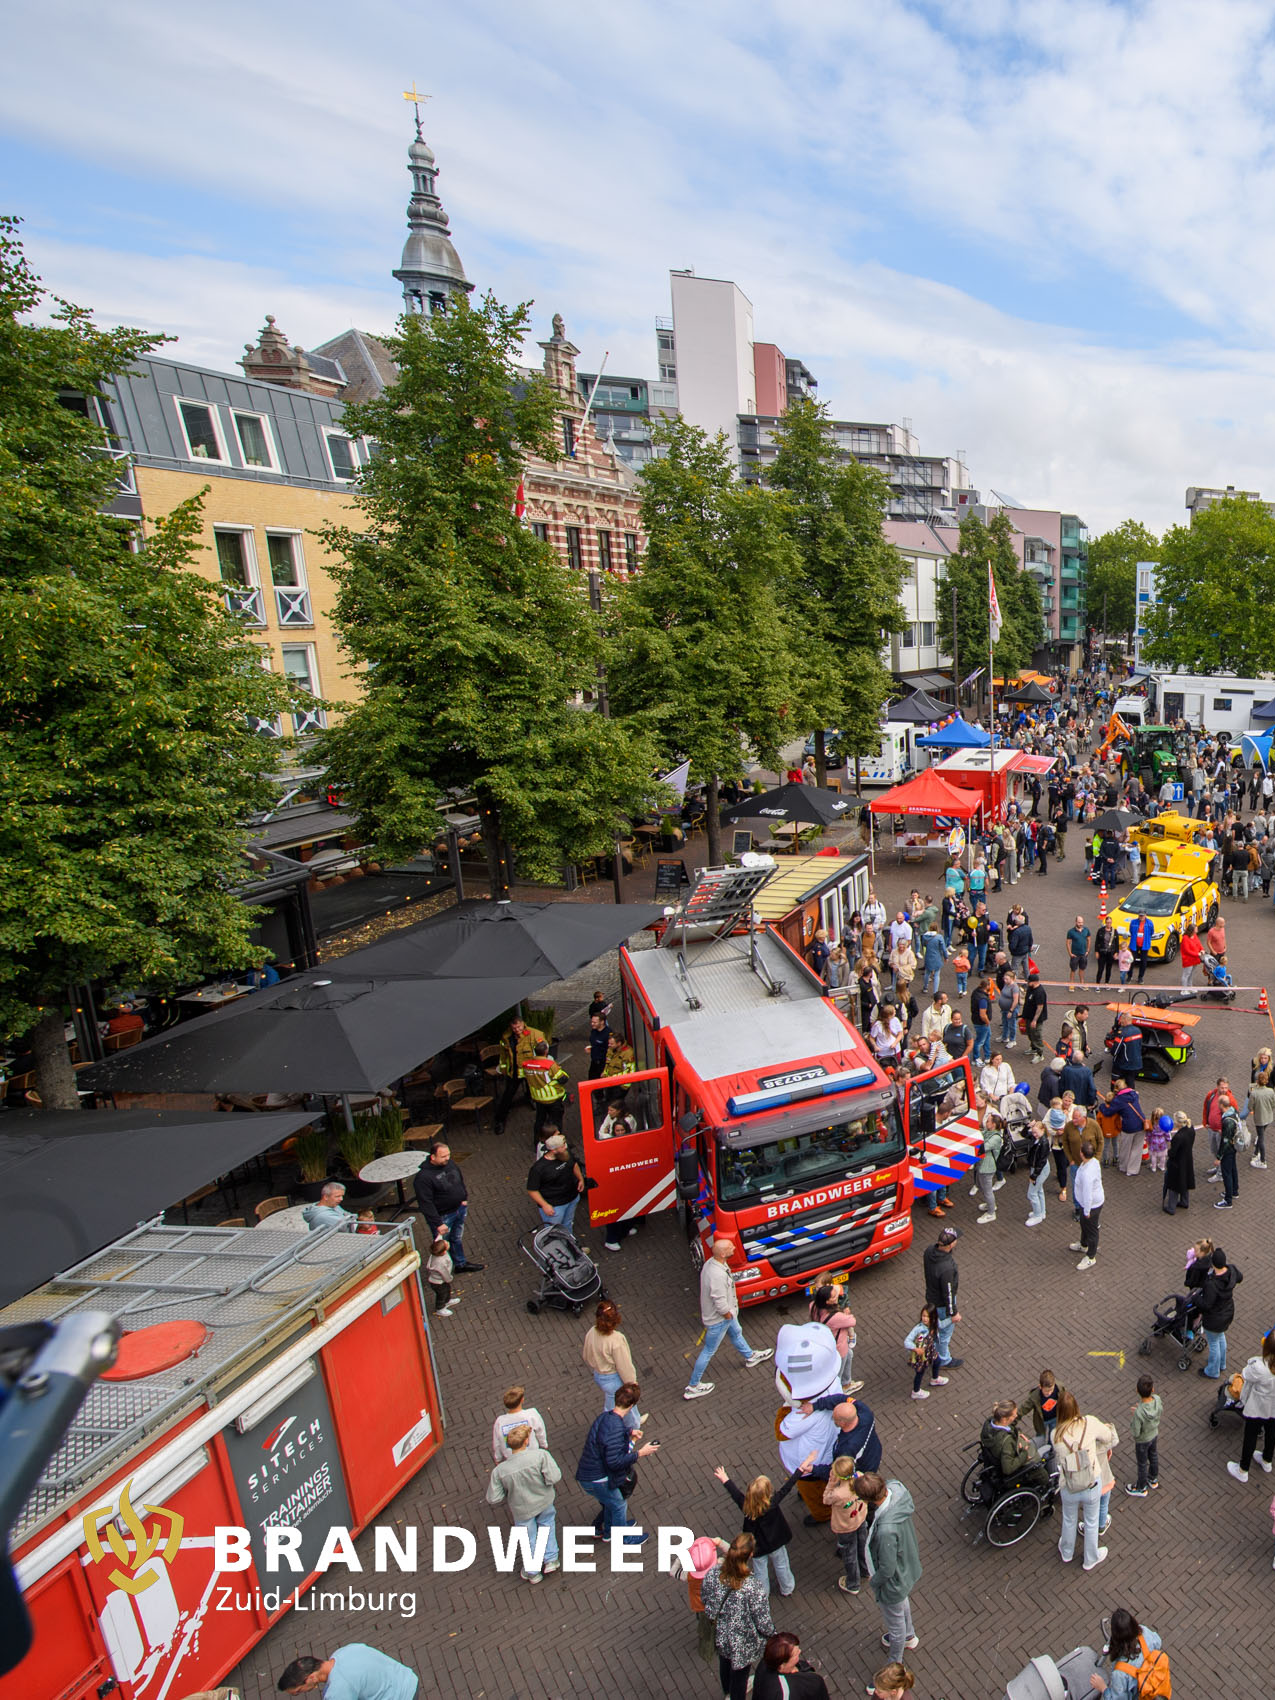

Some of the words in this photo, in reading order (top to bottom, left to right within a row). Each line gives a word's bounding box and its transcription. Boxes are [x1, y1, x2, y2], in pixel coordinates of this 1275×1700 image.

[609, 1157, 659, 1173] BRANDWEER
[767, 1178, 873, 1218] BRANDWEER
[743, 1221, 779, 1237] DAF
[248, 1418, 321, 1490] SITECH
[251, 1433, 325, 1503] SERVICES
[259, 1461, 330, 1534] TRAININGS
[263, 1474, 332, 1547] NTAINER
